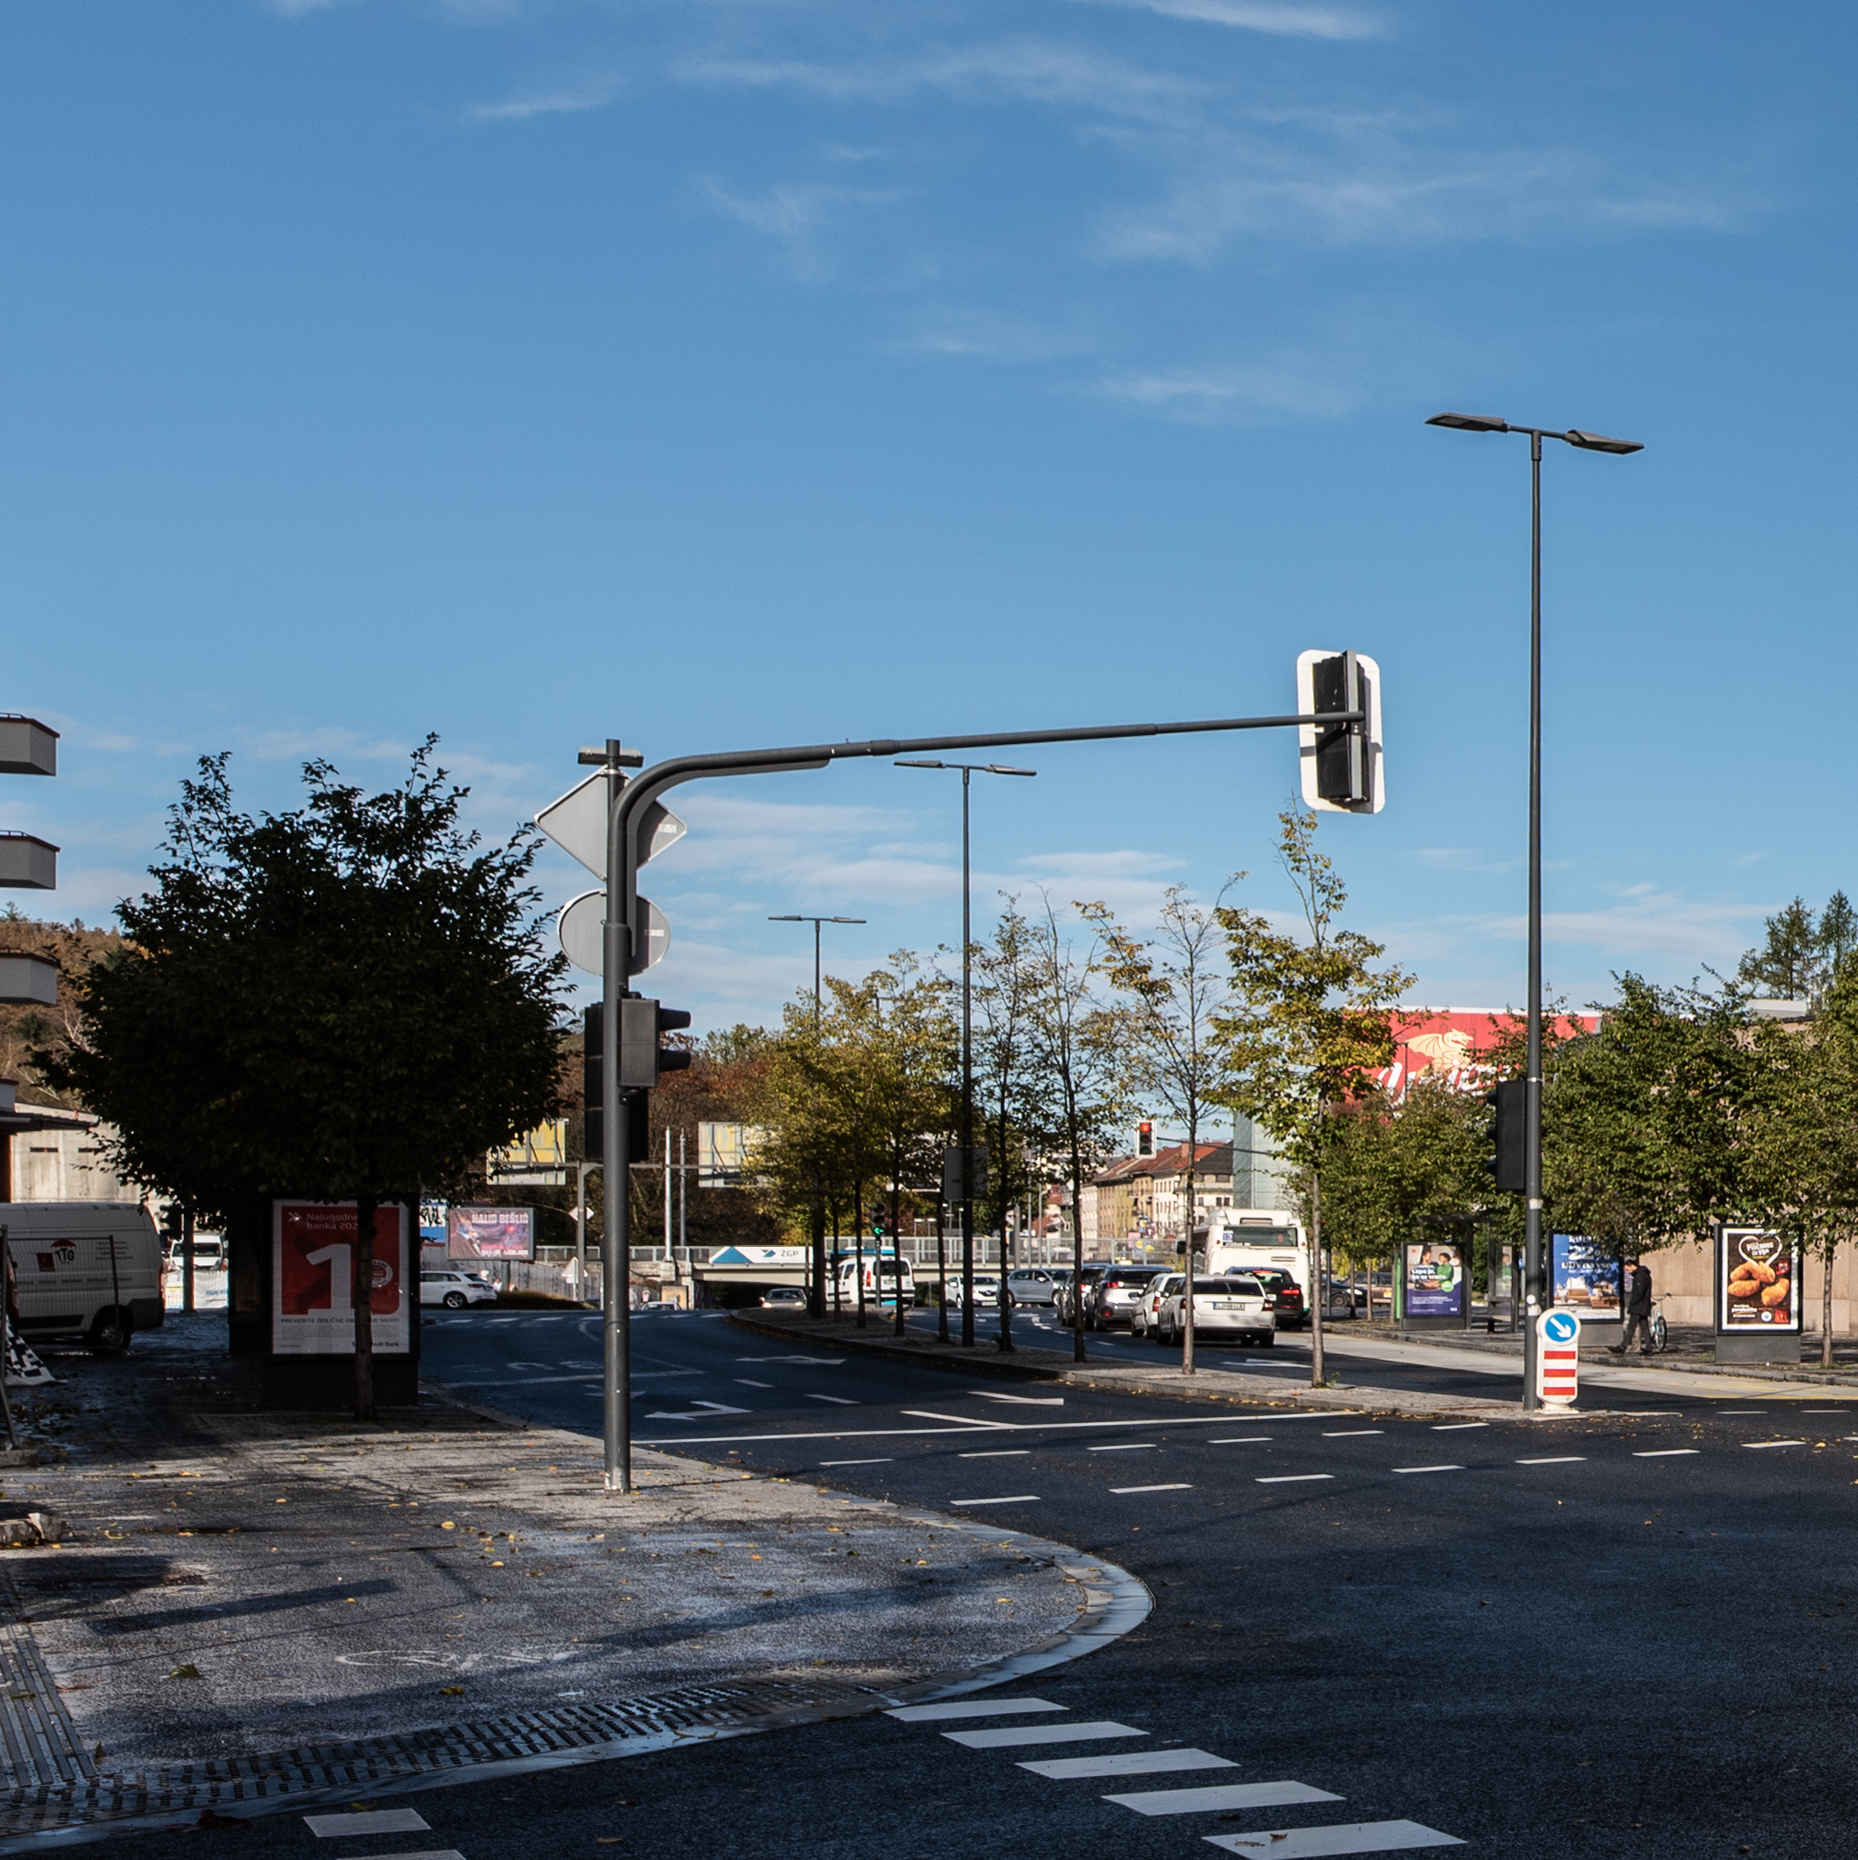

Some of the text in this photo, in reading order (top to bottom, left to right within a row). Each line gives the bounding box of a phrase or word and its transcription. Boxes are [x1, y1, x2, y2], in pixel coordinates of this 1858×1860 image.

[306, 1213, 358, 1223] Najugodne
[471, 1213, 498, 1224] HALID
[306, 1222, 359, 1230] banka 202
